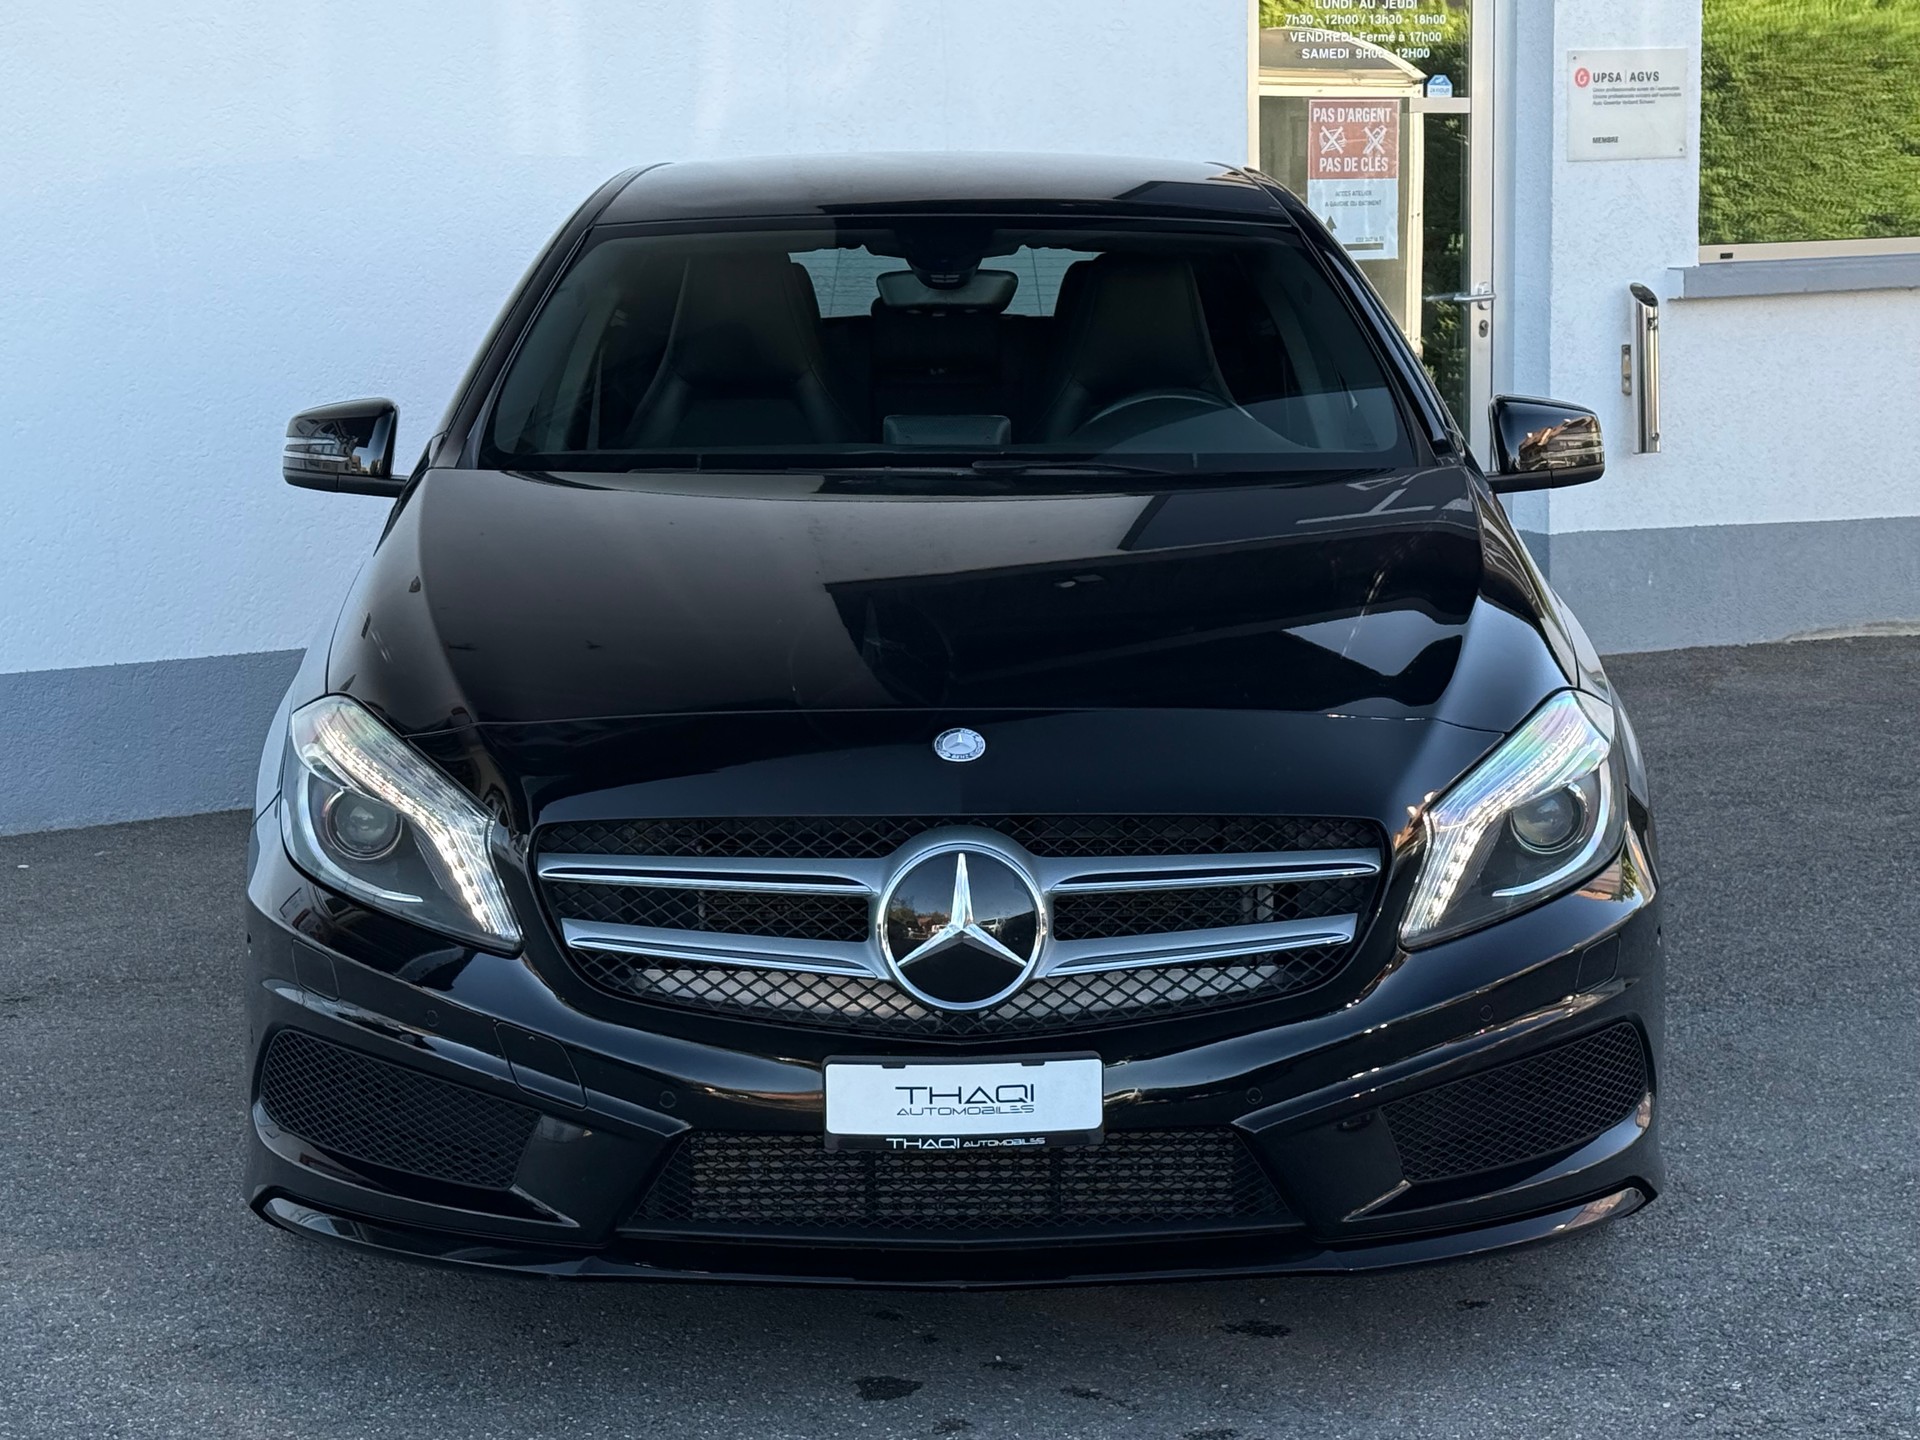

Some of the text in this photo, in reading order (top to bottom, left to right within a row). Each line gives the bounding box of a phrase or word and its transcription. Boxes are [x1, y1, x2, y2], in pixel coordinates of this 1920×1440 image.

[1315, 0, 1418, 9] LUNDI AU JEUDI
[1285, 14, 1314, 25] 7h30
[1325, 14, 1359, 25] 12h00
[1369, 14, 1402, 25] 13h30
[1414, 14, 1447, 25] 18h00
[1290, 31, 1354, 42] VENDREDI
[1360, 31, 1396, 42] Fermé
[1410, 31, 1442, 42] 17h00
[1302, 48, 1350, 59] SAMEDI
[1396, 48, 1431, 59] 12H00
[1592, 71, 1660, 83] UPSA AGVS
[1313, 107, 1392, 123] PAS D'ARGENT
[1319, 154, 1389, 172] PAS DE CLÉS
[895, 1083, 1035, 1105] THAQI
[896, 1105, 1035, 1116] AUTOMOBILES
[886, 1137, 1046, 1149] THAQI AUTOMOBILES
